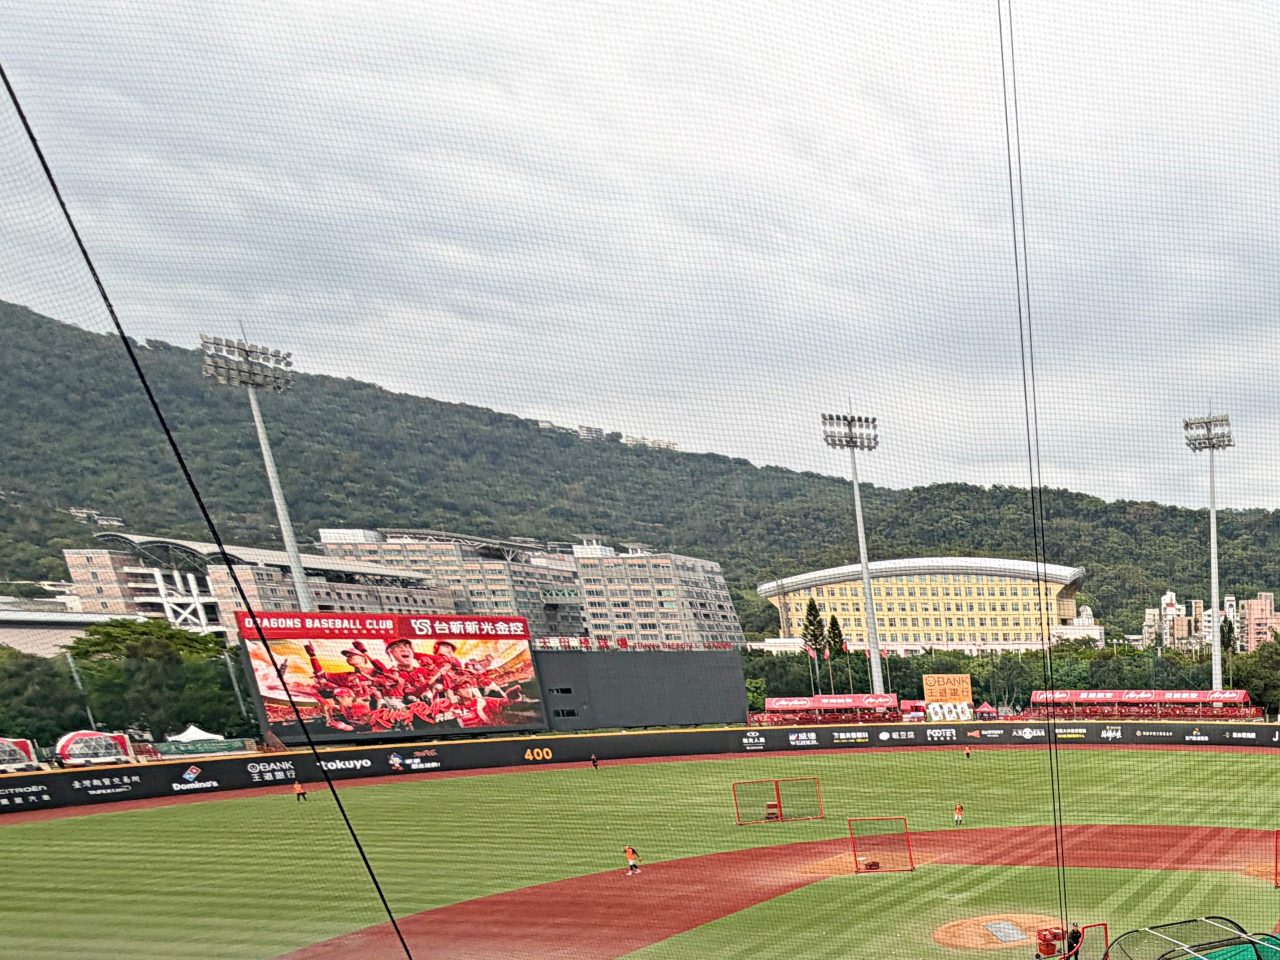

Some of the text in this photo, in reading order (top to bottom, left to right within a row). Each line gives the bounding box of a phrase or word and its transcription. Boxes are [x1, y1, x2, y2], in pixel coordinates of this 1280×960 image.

[244, 617, 394, 629] DRAGONS BASEBALL CLUB
[433, 621, 525, 635] 台新新光金控
[524, 747, 553, 761] 400
[316, 759, 371, 770] tokuyo
[251, 770, 296, 782] 王道銀行
[172, 780, 219, 791] Domino's
